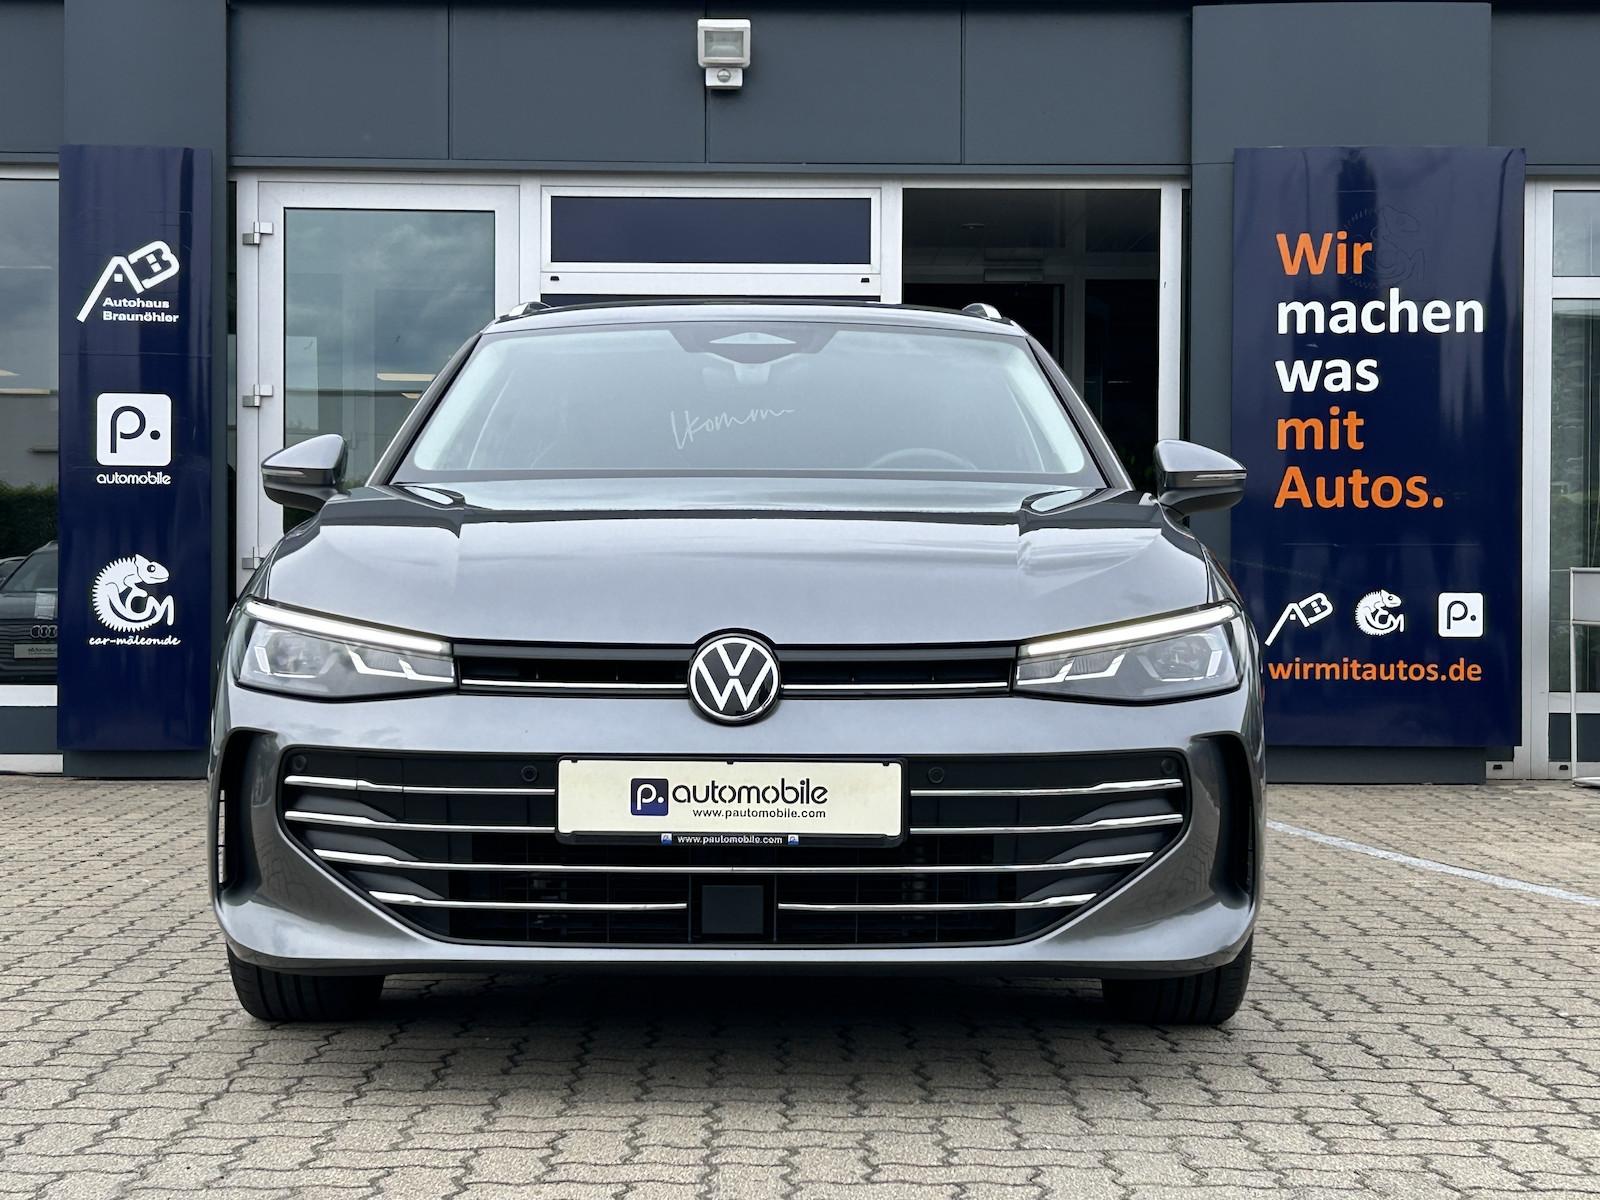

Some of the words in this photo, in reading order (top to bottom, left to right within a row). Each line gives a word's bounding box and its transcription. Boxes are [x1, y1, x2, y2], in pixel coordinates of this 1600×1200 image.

[1276, 231, 1373, 276] Wir
[102, 297, 170, 309] Autohaus
[1277, 287, 1484, 335] machen
[102, 310, 180, 323] Braunöhler
[1275, 358, 1380, 393] was
[1277, 406, 1364, 450] mit
[96, 471, 171, 485] automobile
[1274, 466, 1445, 509] Autos.
[1268, 657, 1483, 682] wirmitautos.de
[671, 777, 829, 805] automobile
[692, 808, 827, 820] www.pautomobile.com
[677, 834, 783, 846] www.pautomobile.com
